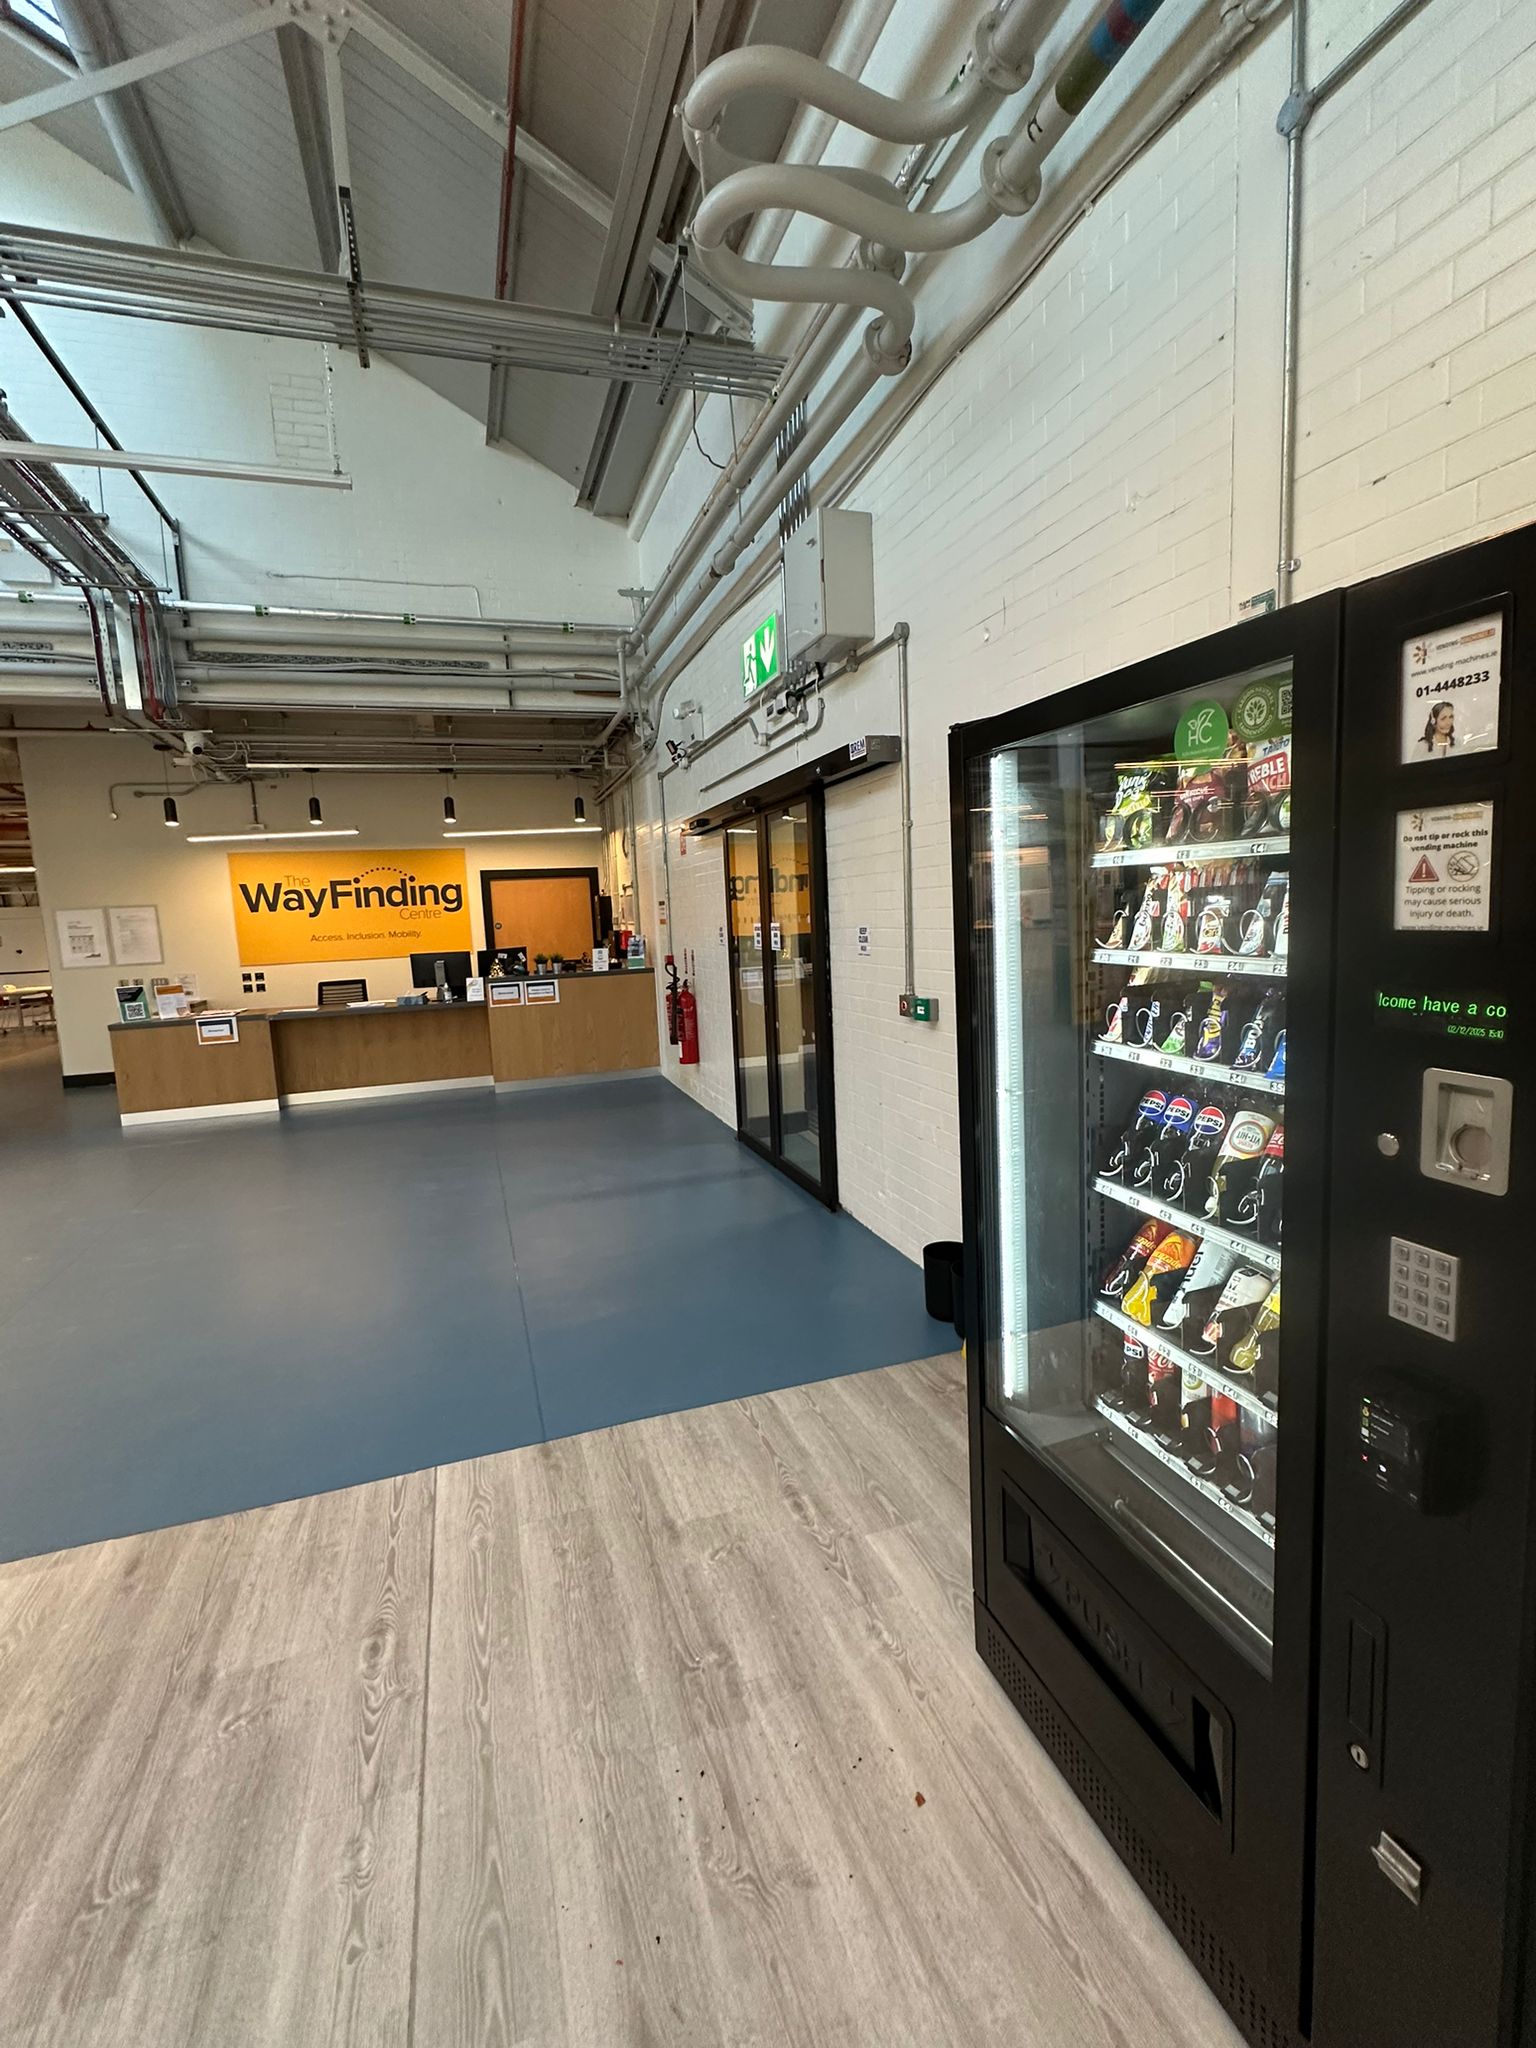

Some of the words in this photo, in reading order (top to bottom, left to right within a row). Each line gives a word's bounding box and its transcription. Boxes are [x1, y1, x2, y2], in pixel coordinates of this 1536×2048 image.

[1411, 650, 1498, 677] www.vending-machines.ie
[1416, 670, 1490, 698] 01-4448233
[1428, 833, 1439, 841] tip
[1452, 830, 1470, 839] rock
[1472, 829, 1488, 837] this
[1411, 843, 1441, 852] vending
[1443, 841, 1478, 850] machine
[284, 874, 310, 888] The
[1405, 885, 1435, 895] Tipping
[1448, 884, 1481, 894] rocking
[239, 875, 463, 918] WayFinding
[1404, 899, 1421, 907] may
[1449, 897, 1481, 905] serious
[400, 907, 442, 920] Centre
[1410, 909, 1432, 919] injury
[1446, 909, 1474, 918] death.
[1423, 995, 1460, 1013] have
[1467, 1003, 1477, 1015] a
[1486, 1005, 1506, 1018] co
